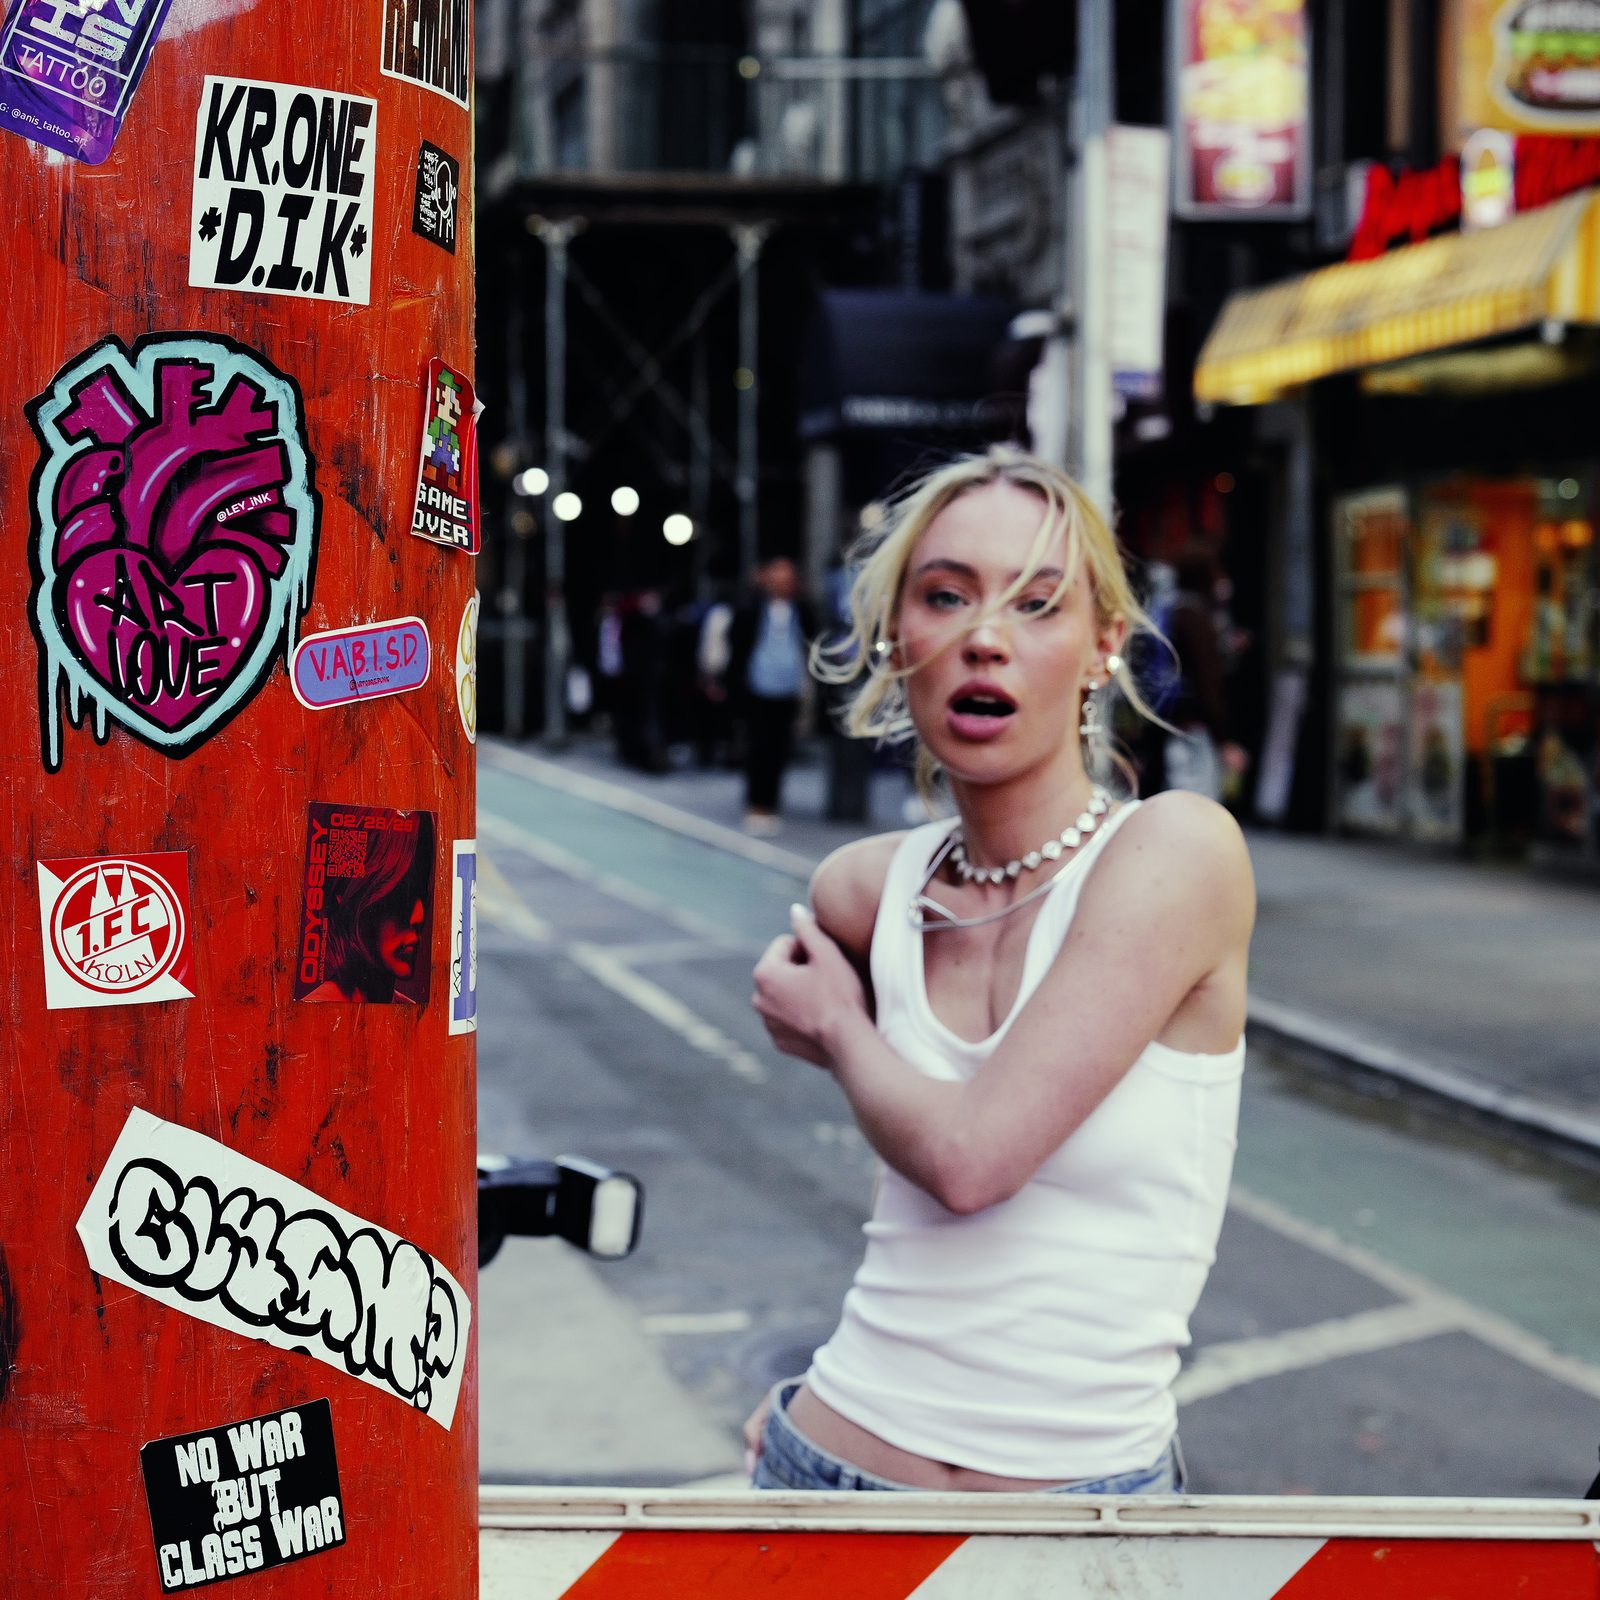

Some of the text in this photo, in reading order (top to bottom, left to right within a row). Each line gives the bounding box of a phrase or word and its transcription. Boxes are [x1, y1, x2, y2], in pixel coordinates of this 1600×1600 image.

[21, 44, 107, 98] TATTOO
[11, 108, 88, 147] @anis_tattoo_art
[199, 82, 373, 197] KR.ONE
[413, 508, 469, 547] OVER
[417, 481, 468, 520] GAME
[93, 553, 237, 638] ART
[108, 629, 229, 706] LOVE
[301, 818, 328, 984] ODYSSEY
[85, 953, 155, 983] KÖLN
[175, 1411, 305, 1487] NO WAR
[211, 1468, 281, 1532] BUT
[160, 1496, 343, 1588] CLASS WAR
